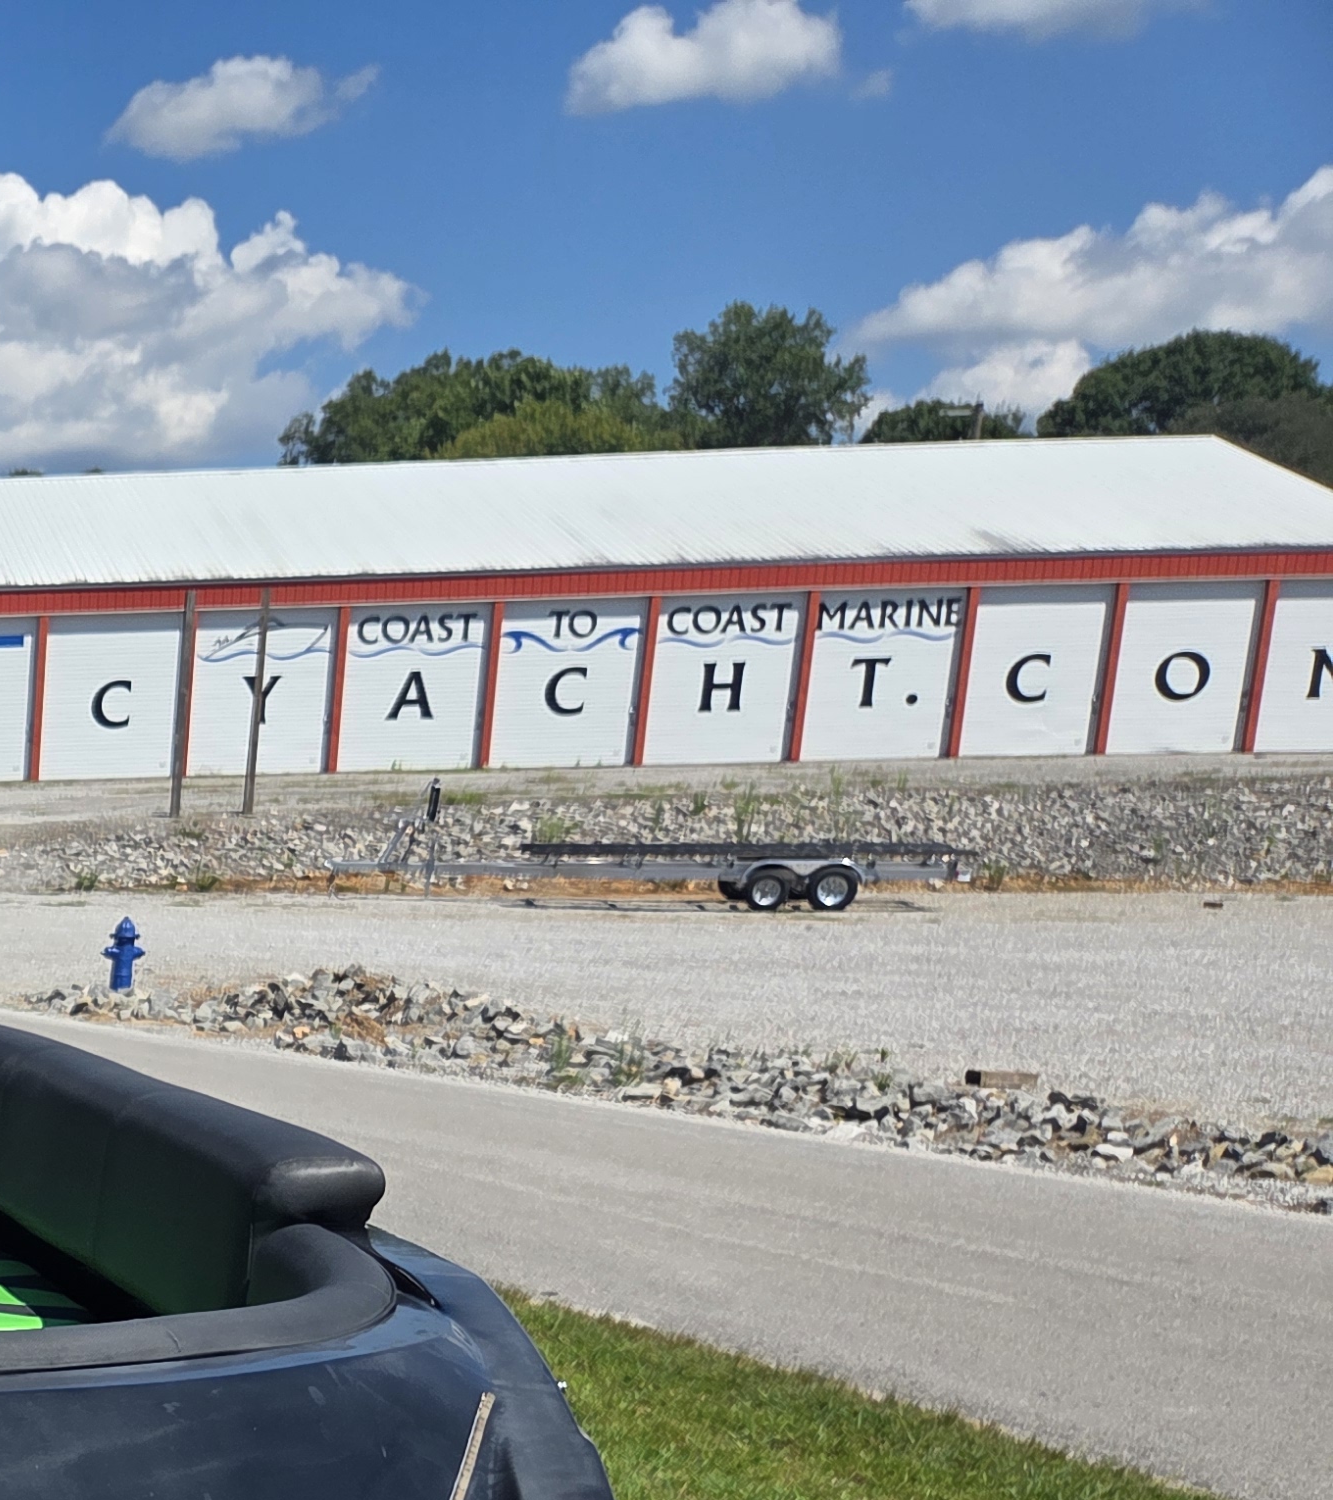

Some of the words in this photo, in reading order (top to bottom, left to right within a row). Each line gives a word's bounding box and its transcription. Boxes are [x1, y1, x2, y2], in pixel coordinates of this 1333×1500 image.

[357, 612, 478, 645] COAST
[548, 609, 598, 639] TO
[666, 602, 792, 636] COAST
[816, 597, 963, 631] MARINE
